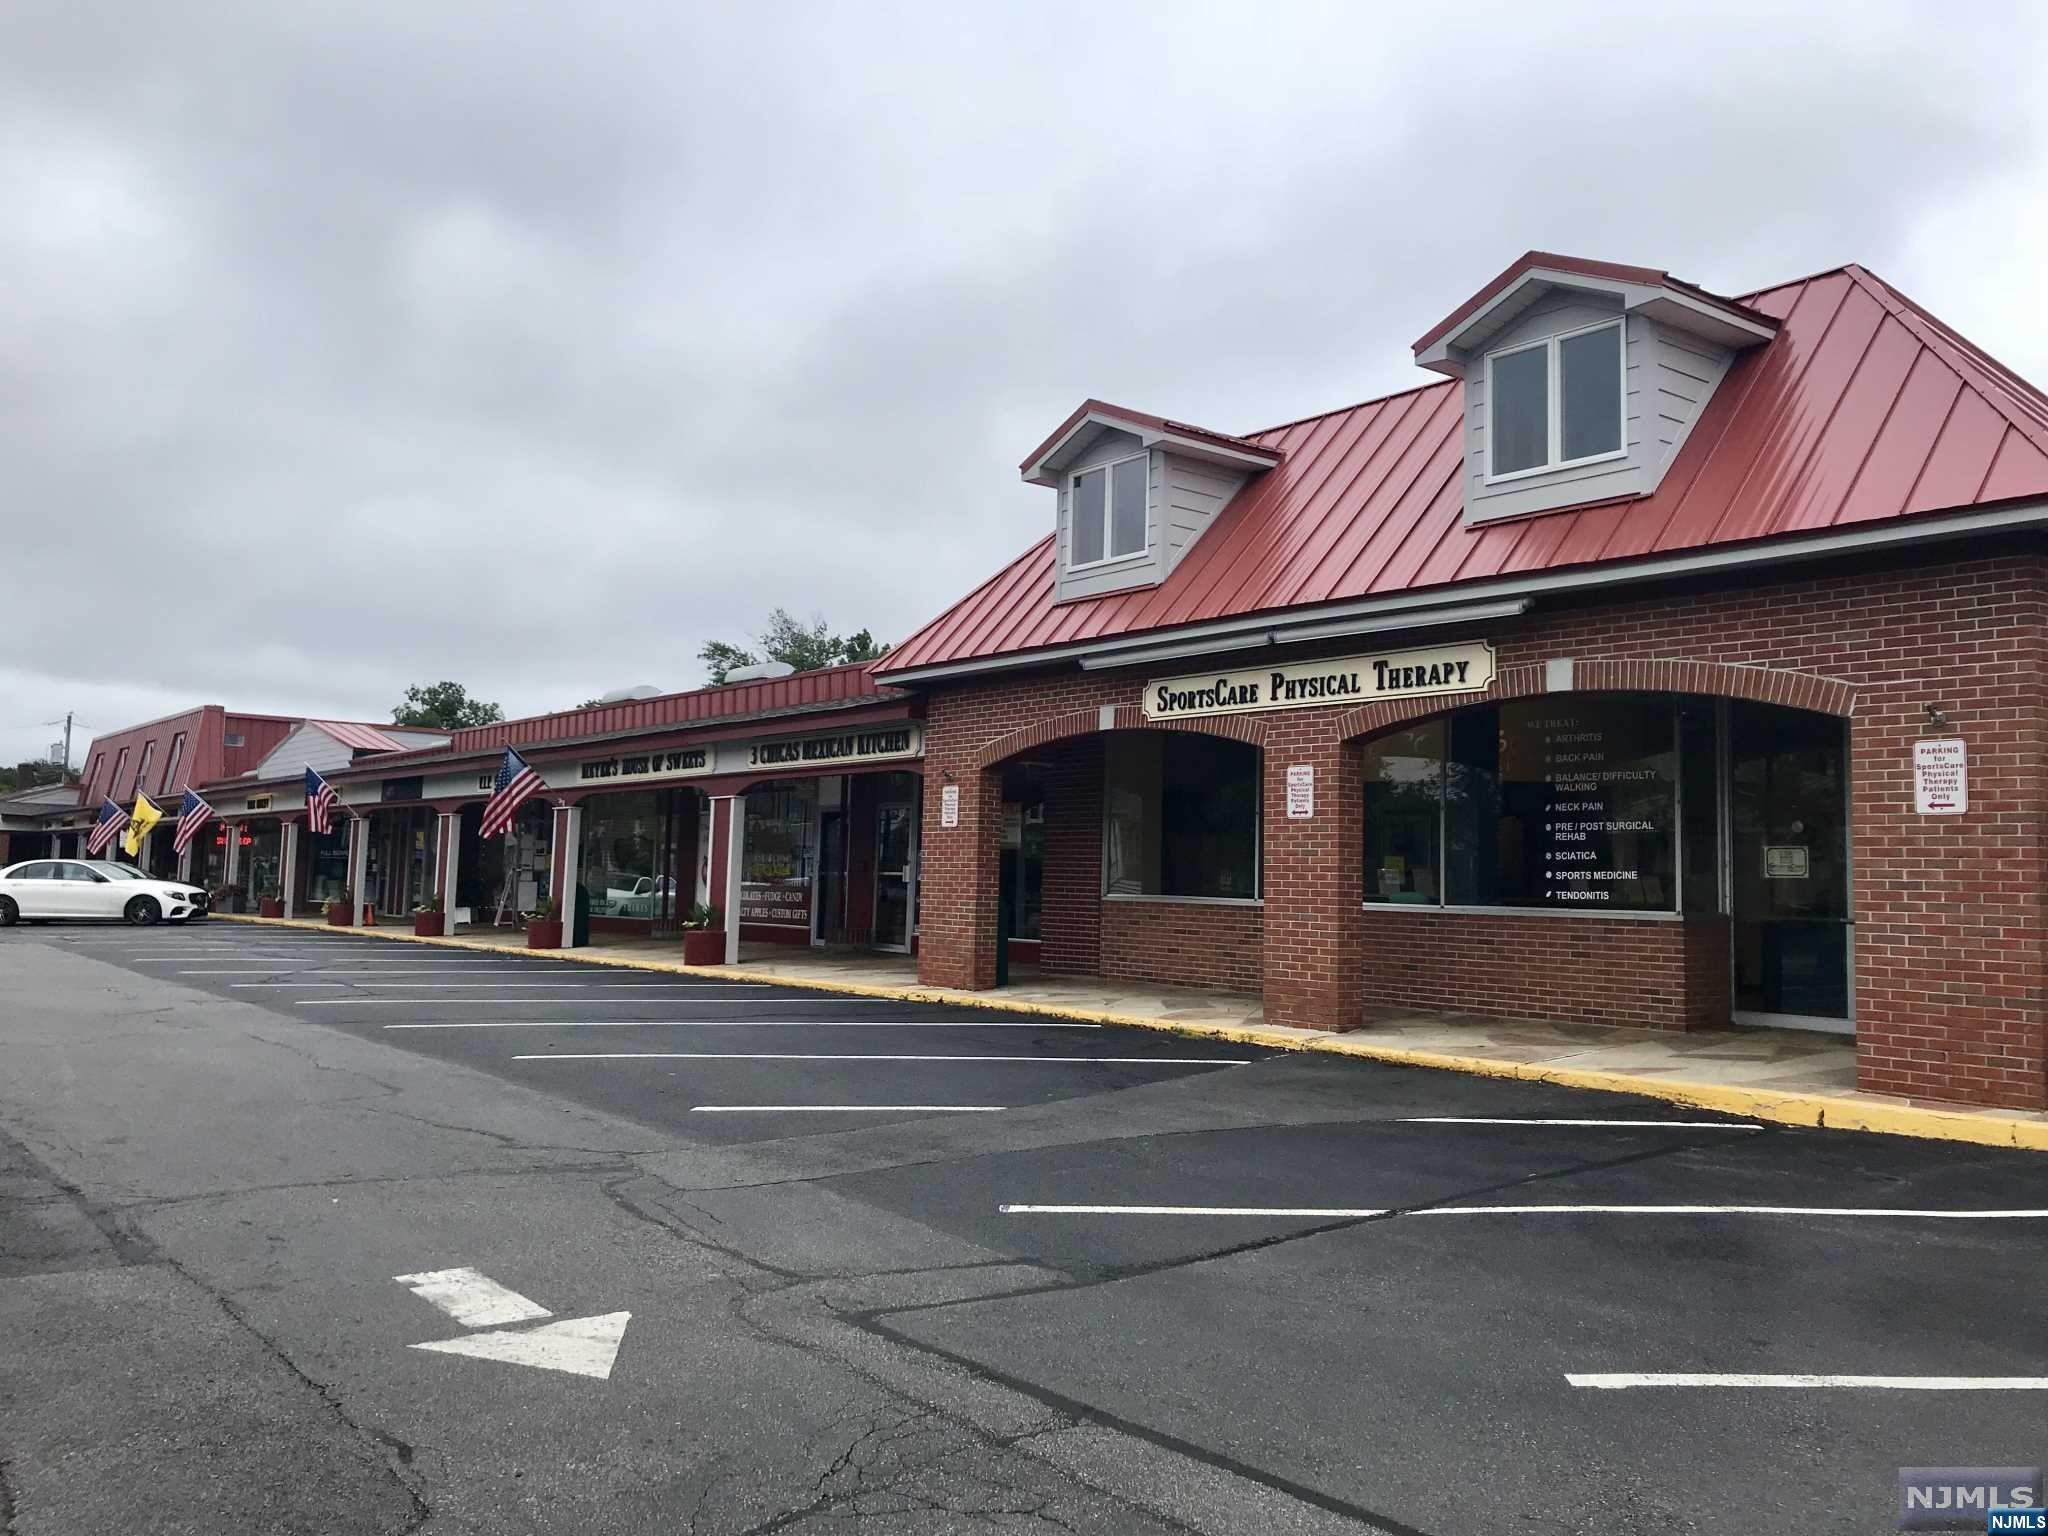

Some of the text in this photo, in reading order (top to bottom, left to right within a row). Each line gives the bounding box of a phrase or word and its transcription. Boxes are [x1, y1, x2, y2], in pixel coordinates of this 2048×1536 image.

[1555, 732, 1603, 744] ARTHRITIS
[750, 729, 911, 765] 3 CHICAS MEXICAN KITCHEN
[1920, 747, 1959, 755] PARKING
[622, 757, 650, 775] HOUSE
[652, 754, 665, 772] OF
[666, 750, 706, 771] SWEETS
[1555, 752, 1604, 763] BACK PAIN
[1916, 763, 1963, 771] SportsCare
[1603, 770, 1657, 781] DIFFICULTY
[1922, 770, 1958, 779] Physical
[1555, 782, 1598, 792] WALKING
[1555, 802, 1604, 812] NECK PAIN
[1555, 823, 1573, 831] PRE
[1580, 822, 1604, 831] POST
[1606, 820, 1654, 831] SURGICAL
[1555, 832, 1586, 841] REHAB
[1555, 851, 1597, 860] SCIATICA
[1555, 870, 1638, 880] SPORTS MEDICINE
[1556, 891, 1610, 900] TENDONITIS
